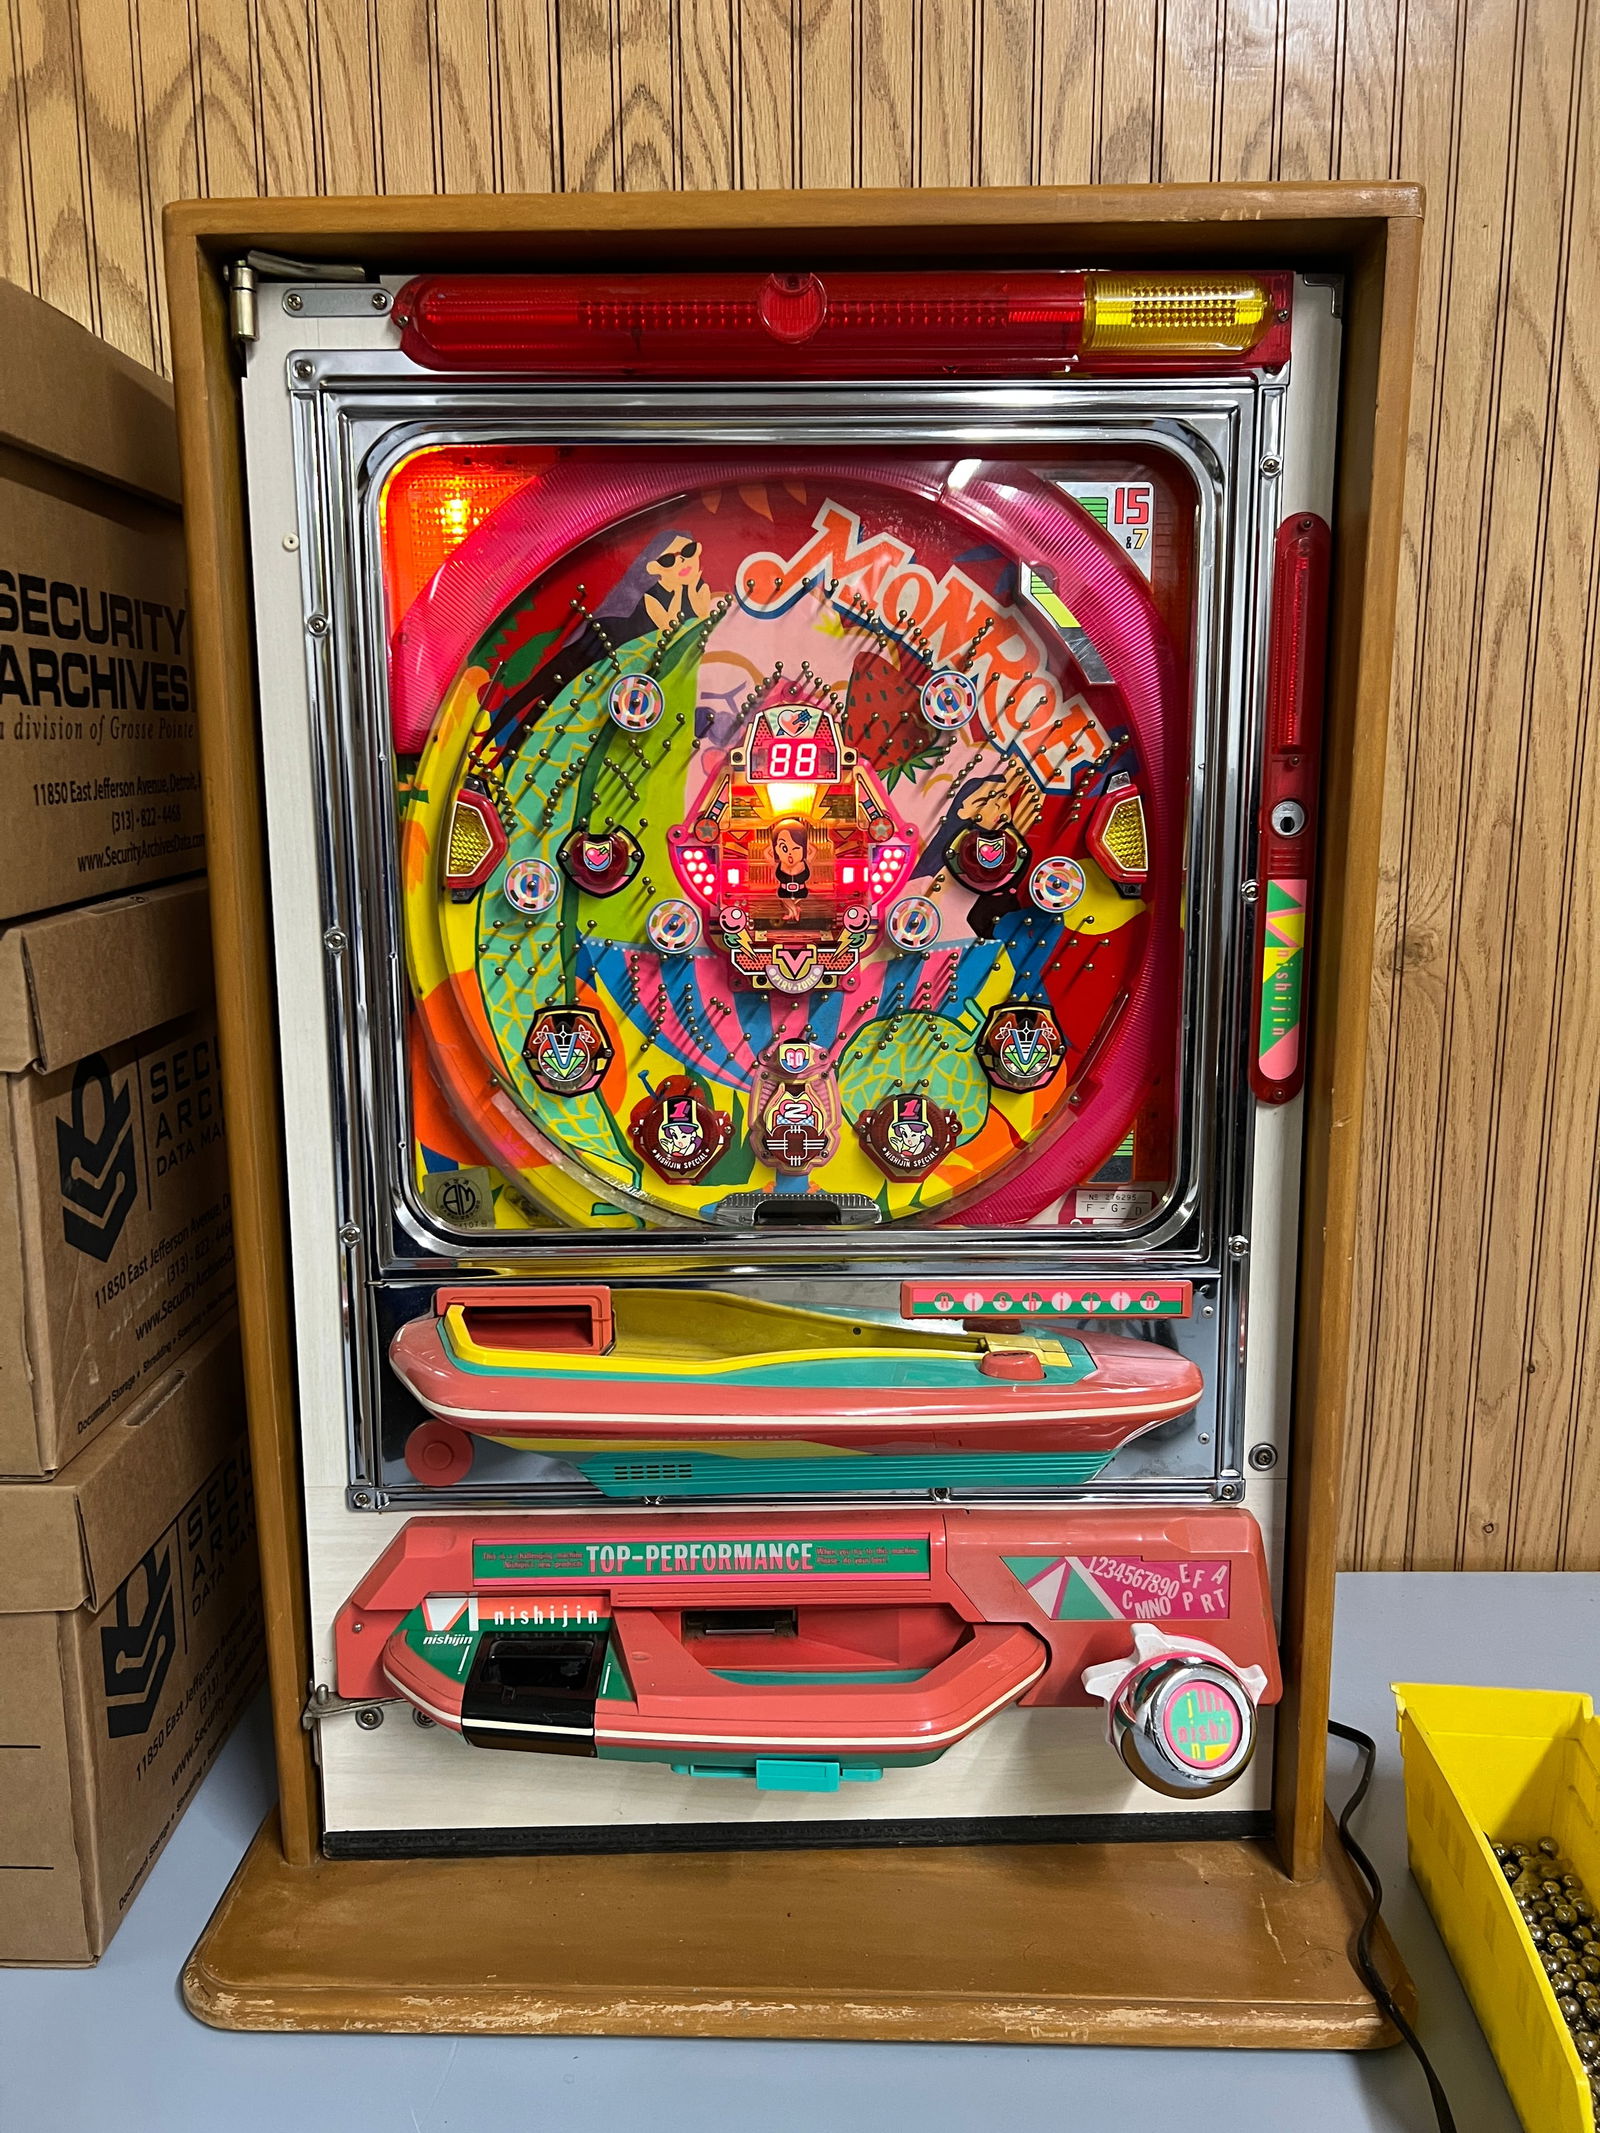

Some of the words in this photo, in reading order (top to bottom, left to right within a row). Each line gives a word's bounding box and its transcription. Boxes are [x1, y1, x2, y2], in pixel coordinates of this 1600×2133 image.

[1114, 487, 1150, 524] 15
[1125, 536, 1132, 549] &
[1132, 528, 1149, 550] 7
[0, 570, 186, 655] SECURITY
[0, 645, 190, 712] ARCHIVES
[14, 712, 83, 740] division
[89, 715, 105, 746] of
[110, 716, 154, 740] Grosse
[157, 717, 194, 740] Pointe
[769, 743, 818, 778] 88
[33, 781, 68, 806] 11850
[69, 780, 92, 803] East
[93, 777, 135, 801] Jefferson
[111, 808, 135, 835] (313)
[141, 807, 157, 828] 822
[1270, 950, 1294, 1036] nishijin
[669, 1101, 689, 1119] 1
[900, 1099, 919, 1117] 1
[157, 1139, 195, 1177] DATA
[654, 1152, 681, 1170] NISHIJIN
[684, 1152, 708, 1169] SPECIAL
[884, 1150, 911, 1168] NISHIJIN
[913, 1151, 938, 1168] SPECIAL
[95, 1271, 126, 1310] 11850
[127, 1254, 148, 1286] East
[149, 1224, 189, 1268] Jefferson
[167, 1252, 188, 1287] (313)
[940, 1293, 1154, 1313] nishijin
[76, 1396, 112, 1435] Document
[111, 1374, 136, 1404] Storage
[586, 1543, 813, 1573] TOP-PERFORMANCE
[1088, 1556, 1180, 1600] 1234567890
[1179, 1563, 1191, 1584] E
[1193, 1570, 1205, 1588] F
[1211, 1565, 1228, 1585] A
[1181, 1591, 1194, 1611] P
[1200, 1593, 1216, 1614] R
[1213, 1588, 1227, 1609] T
[494, 1605, 598, 1628] nishijin
[422, 1633, 474, 1647] nishijin
[136, 1732, 165, 1782] 11850
[165, 1707, 185, 1738] East
